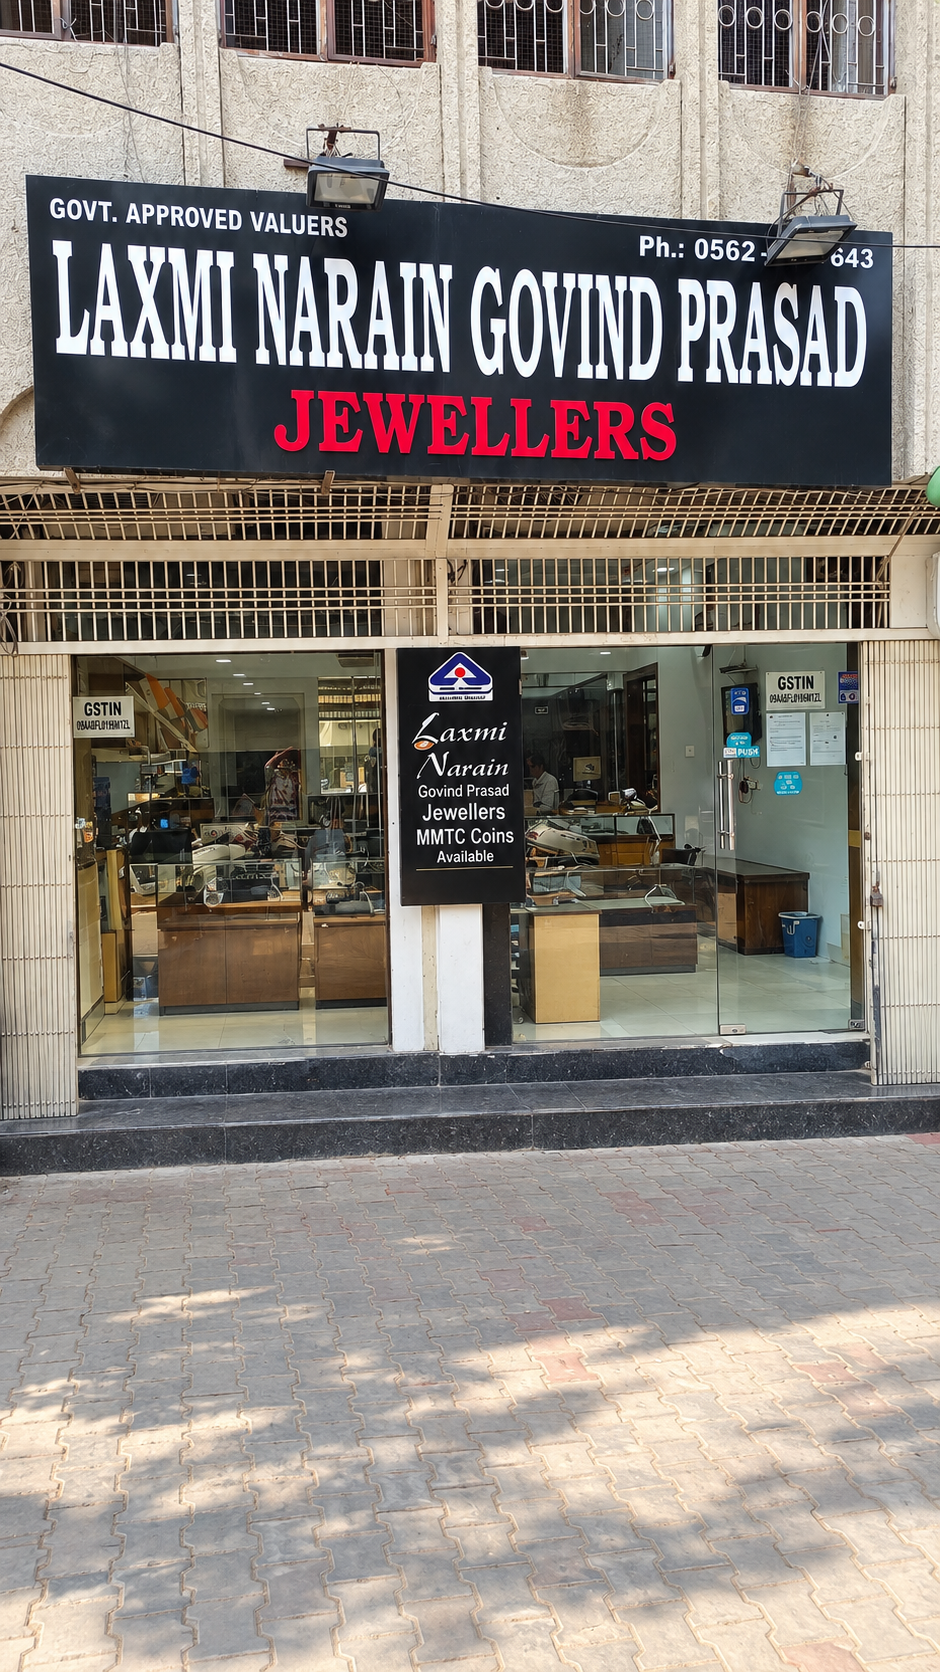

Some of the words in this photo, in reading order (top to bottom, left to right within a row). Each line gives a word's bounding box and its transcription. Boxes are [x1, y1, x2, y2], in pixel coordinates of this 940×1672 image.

[50, 198, 117, 222] GOVT.
[126, 203, 242, 230] APPROVED
[250, 211, 347, 237] VALUERS
[640, 236, 683, 258] Ph.:
[53, 240, 236, 363] LAXMI
[253, 253, 452, 372] NARAIN
[471, 266, 662, 380] GOVIND
[678, 279, 866, 387] PRASAD
[274, 390, 676, 460] JEWELLERS
[778, 676, 813, 690] GSTIN
[84, 702, 121, 716] GSTIN
[412, 712, 507, 744] Laxmi
[417, 752, 508, 779] Narain
[419, 785, 462, 797] Govind
[467, 784, 509, 796] Prasad
[423, 803, 505, 821] Jewellers
[417, 828, 465, 845] MMTC
[471, 828, 514, 844] Coins
[437, 850, 493, 862] Available
